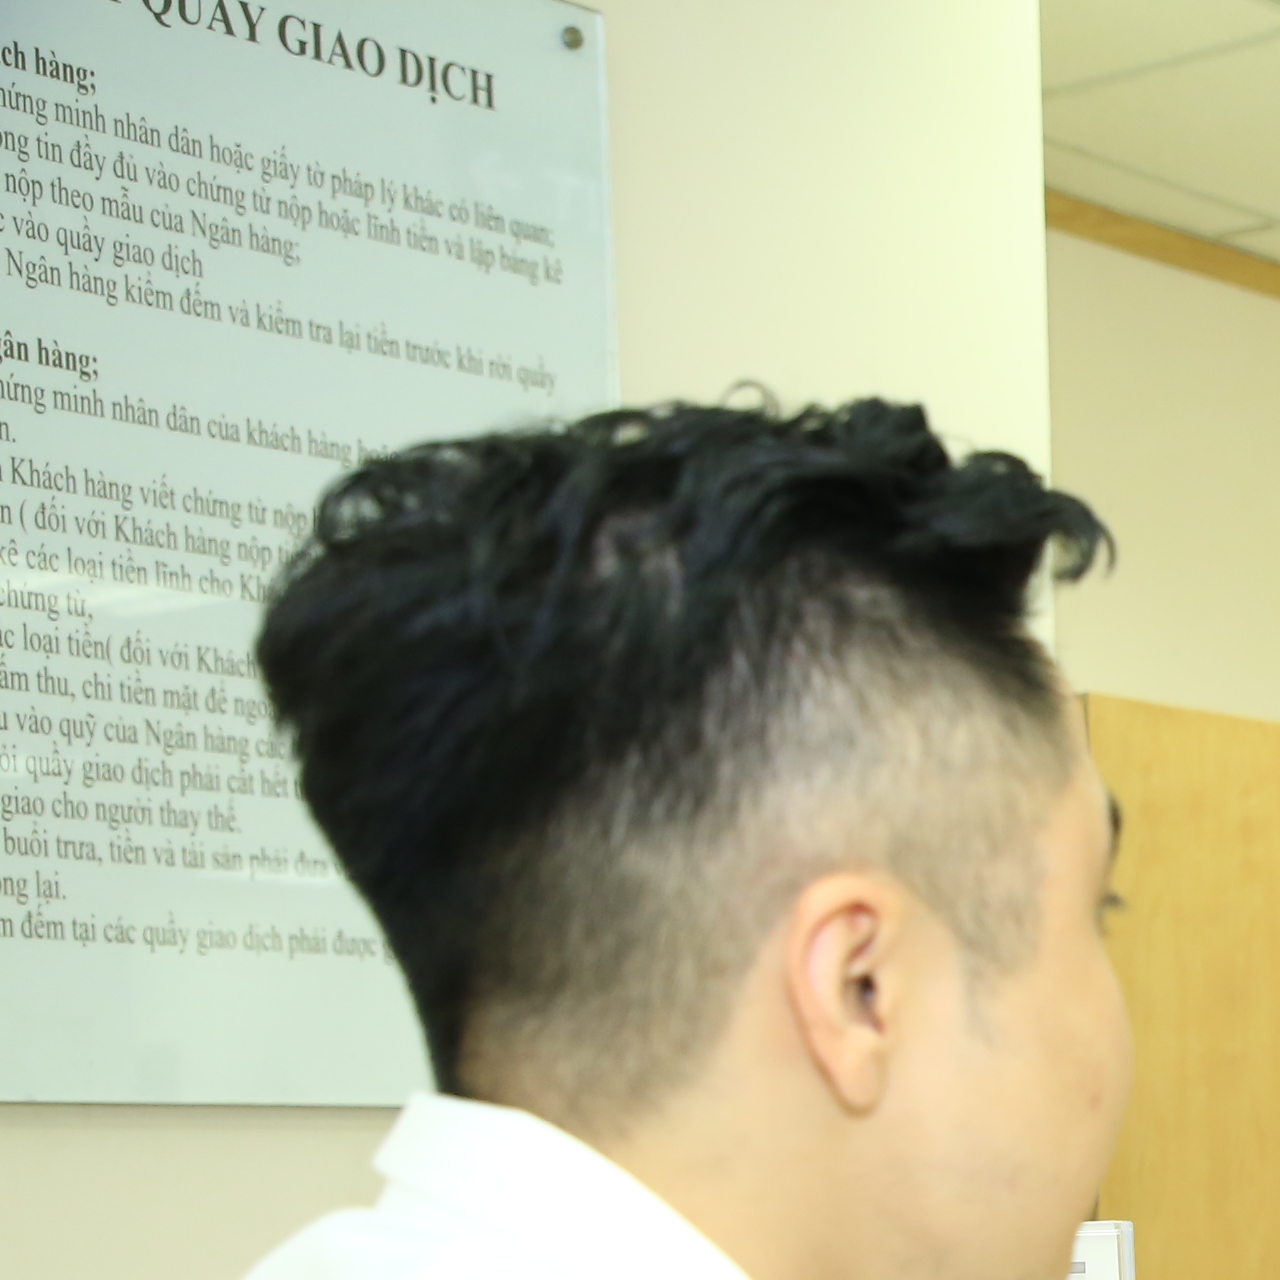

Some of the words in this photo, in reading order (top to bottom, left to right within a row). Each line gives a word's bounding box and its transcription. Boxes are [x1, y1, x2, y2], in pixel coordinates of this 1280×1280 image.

[34, 46, 96, 96] hàng;
[278, 14, 386, 78] GIAO
[397, 46, 496, 111] DỊCH
[54, 98, 107, 135] minh
[113, 113, 161, 148] nhân
[168, 126, 202, 158] dân
[209, 135, 254, 173] hoặc
[261, 145, 300, 189] giấy
[306, 161, 325, 188] tờ
[331, 168, 375, 207] pháp
[380, 177, 397, 213] lý
[402, 184, 444, 217] khác
[5, 168, 43, 207] nộp
[50, 177, 94, 212] theo
[101, 185, 144, 224] mẫu
[150, 203, 185, 235] của
[191, 209, 243, 250] Ngân
[249, 222, 301, 267] hàng;
[37, 132, 63, 164] tin
[70, 134, 107, 181] đầy
[113, 150, 138, 183] đủ
[145, 161, 180, 192] vào
[186, 171, 247, 217] chứng
[252, 187, 272, 216] từ
[278, 193, 312, 231] nộp
[317, 201, 360, 239] hoặc
[406, 217, 440, 256] tiền
[444, 234, 465, 261] và
[12, 211, 49, 243] vào
[56, 215, 105, 262] quầy
[112, 233, 154, 268] giao
[161, 243, 204, 279] dịch
[5, 247, 61, 289] Ngân
[69, 262, 118, 307] hàng
[124, 271, 174, 311] kiểm
[180, 282, 222, 322] đếm
[229, 300, 250, 328] và
[256, 299, 303, 339] kiểm
[308, 318, 333, 345] tra
[339, 320, 361, 354] lại
[366, 320, 400, 359] tiền
[37, 337, 98, 382] hàng;
[52, 384, 105, 418] minh
[112, 395, 160, 429] nhân
[166, 404, 201, 436] dân
[207, 414, 241, 443] của
[246, 418, 302, 455] khách
[307, 429, 352, 470] hàng
[10, 456, 76, 494] Khách
[84, 469, 132, 511] hàng
[139, 474, 176, 510] viết
[182, 487, 242, 528] chứng
[247, 496, 267, 525] từ
[273, 502, 307, 537] nộp
[34, 495, 67, 532] đối
[75, 510, 107, 539] với
[114, 514, 178, 551] Khách
[184, 523, 230, 566] hàng
[237, 535, 272, 571] nộp
[26, 543, 59, 571] các
[67, 546, 104, 583] loại
[111, 547, 148, 585] tiền
[155, 560, 192, 593] lĩnh
[199, 568, 234, 598] cho
[66, 586, 93, 621] từ,
[23, 623, 61, 659] loại
[120, 629, 152, 666] đối
[159, 642, 190, 670] với
[197, 646, 258, 680] Khách
[37, 666, 75, 700] thu,
[82, 672, 113, 701] chi
[119, 669, 157, 709] tiền
[163, 684, 199, 717] mặt
[15, 706, 52, 735] vào
[59, 712, 96, 747] quỹ
[104, 716, 138, 744] của
[145, 719, 198, 755] Ngân
[203, 724, 250, 763] hàng
[25, 741, 74, 785] quầy
[82, 752, 124, 789] giao
[132, 759, 173, 790] dịch
[180, 764, 221, 797] phải
[1, 786, 45, 821] giao
[52, 791, 88, 820] cho
[95, 797, 152, 830] người
[160, 799, 200, 836] thay
[3, 821, 49, 858] buổi
[56, 834, 102, 865] trưa,
[110, 828, 146, 865] tiền
[153, 840, 175, 867] và
[182, 842, 206, 869] tài
[36, 870, 66, 904] lại.
[20, 904, 64, 941] đếm
[72, 914, 96, 947] tại
[104, 915, 136, 944] các
[142, 911, 187, 954] quầy
[196, 920, 236, 955] giao
[243, 923, 283, 956] dịch
